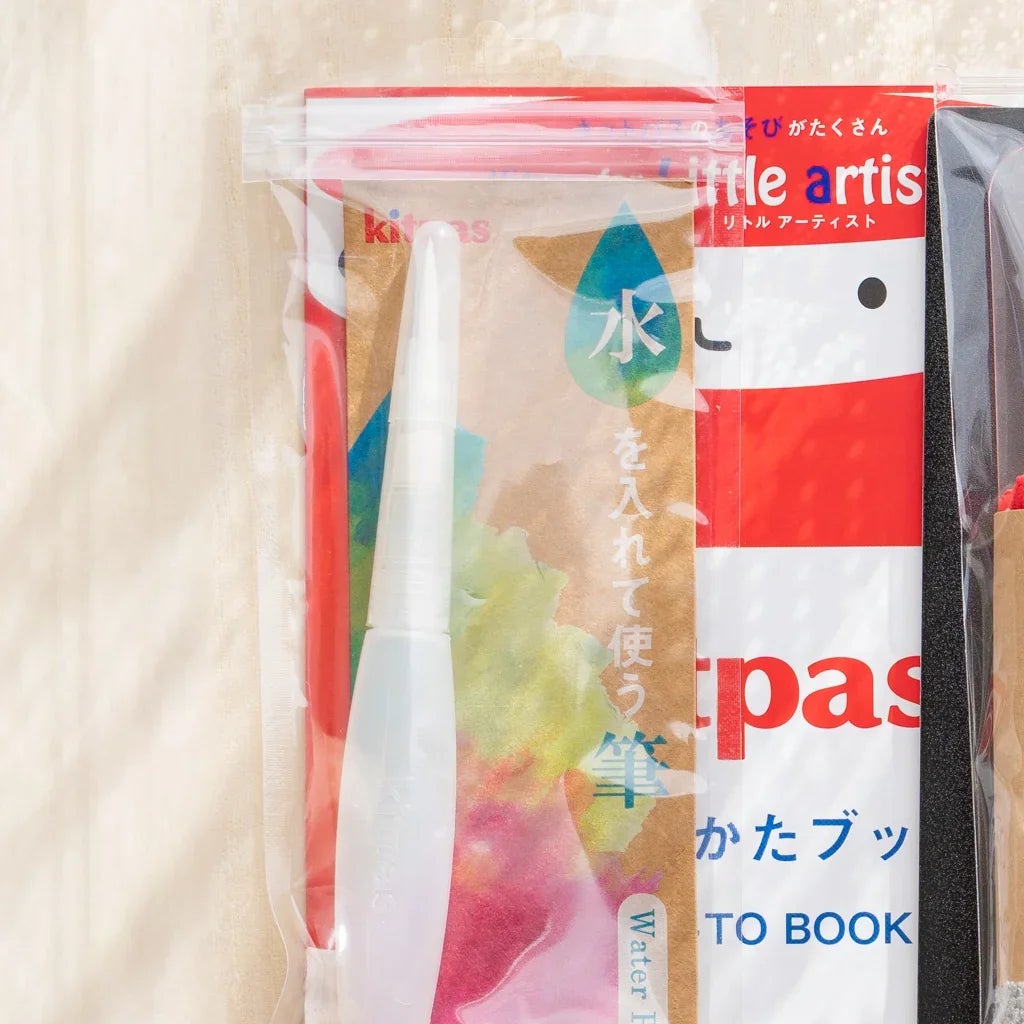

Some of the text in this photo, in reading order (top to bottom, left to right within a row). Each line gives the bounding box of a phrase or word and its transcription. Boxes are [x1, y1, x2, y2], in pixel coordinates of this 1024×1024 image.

[805, 153, 926, 206] artis
[364, 207, 490, 244] kitas
[723, 213, 877, 231] リトル アーティスト
[695, 655, 921, 761] pas
[785, 911, 913, 945] BOOK
[629, 908, 656, 1000] Water
